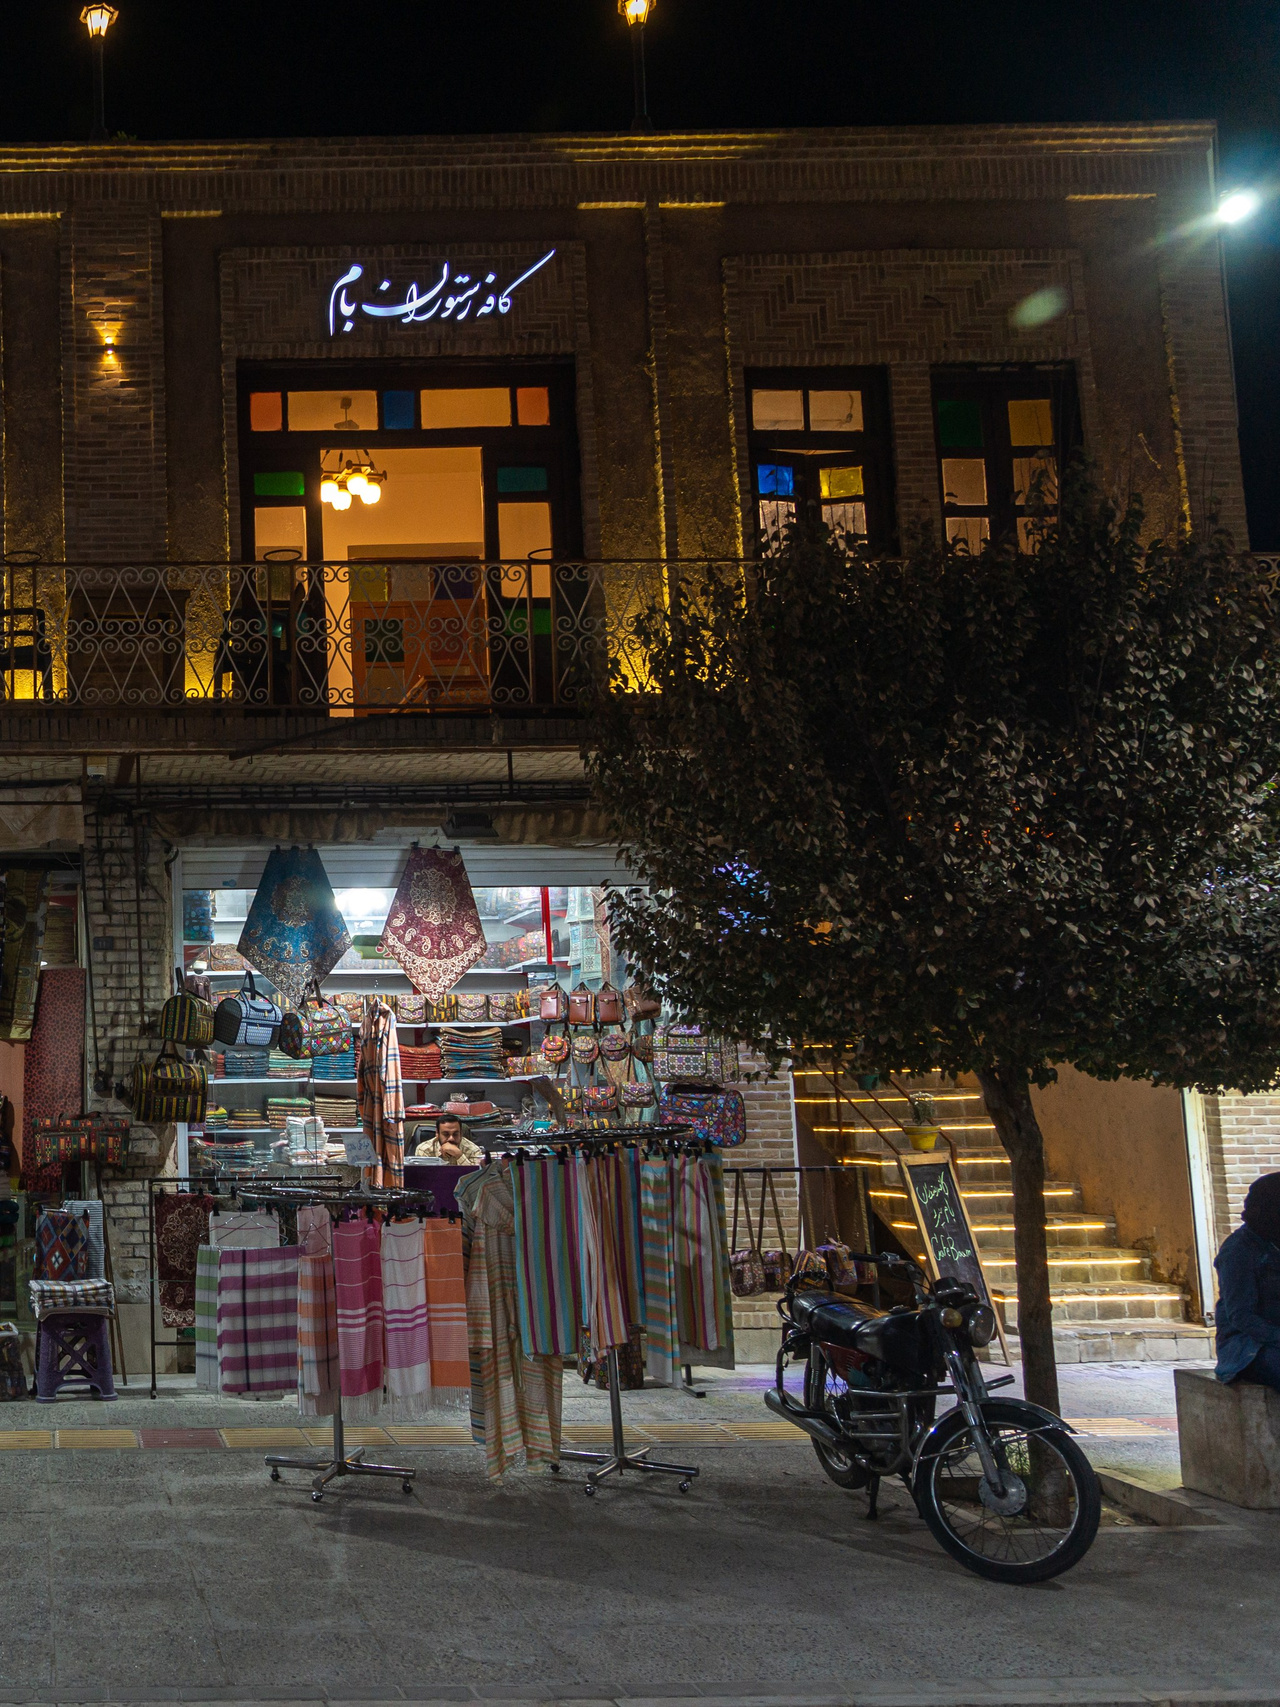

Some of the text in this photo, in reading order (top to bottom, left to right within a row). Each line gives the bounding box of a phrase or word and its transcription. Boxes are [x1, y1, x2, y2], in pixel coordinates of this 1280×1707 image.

[328, 248, 556, 337] کافه رستوران بام
